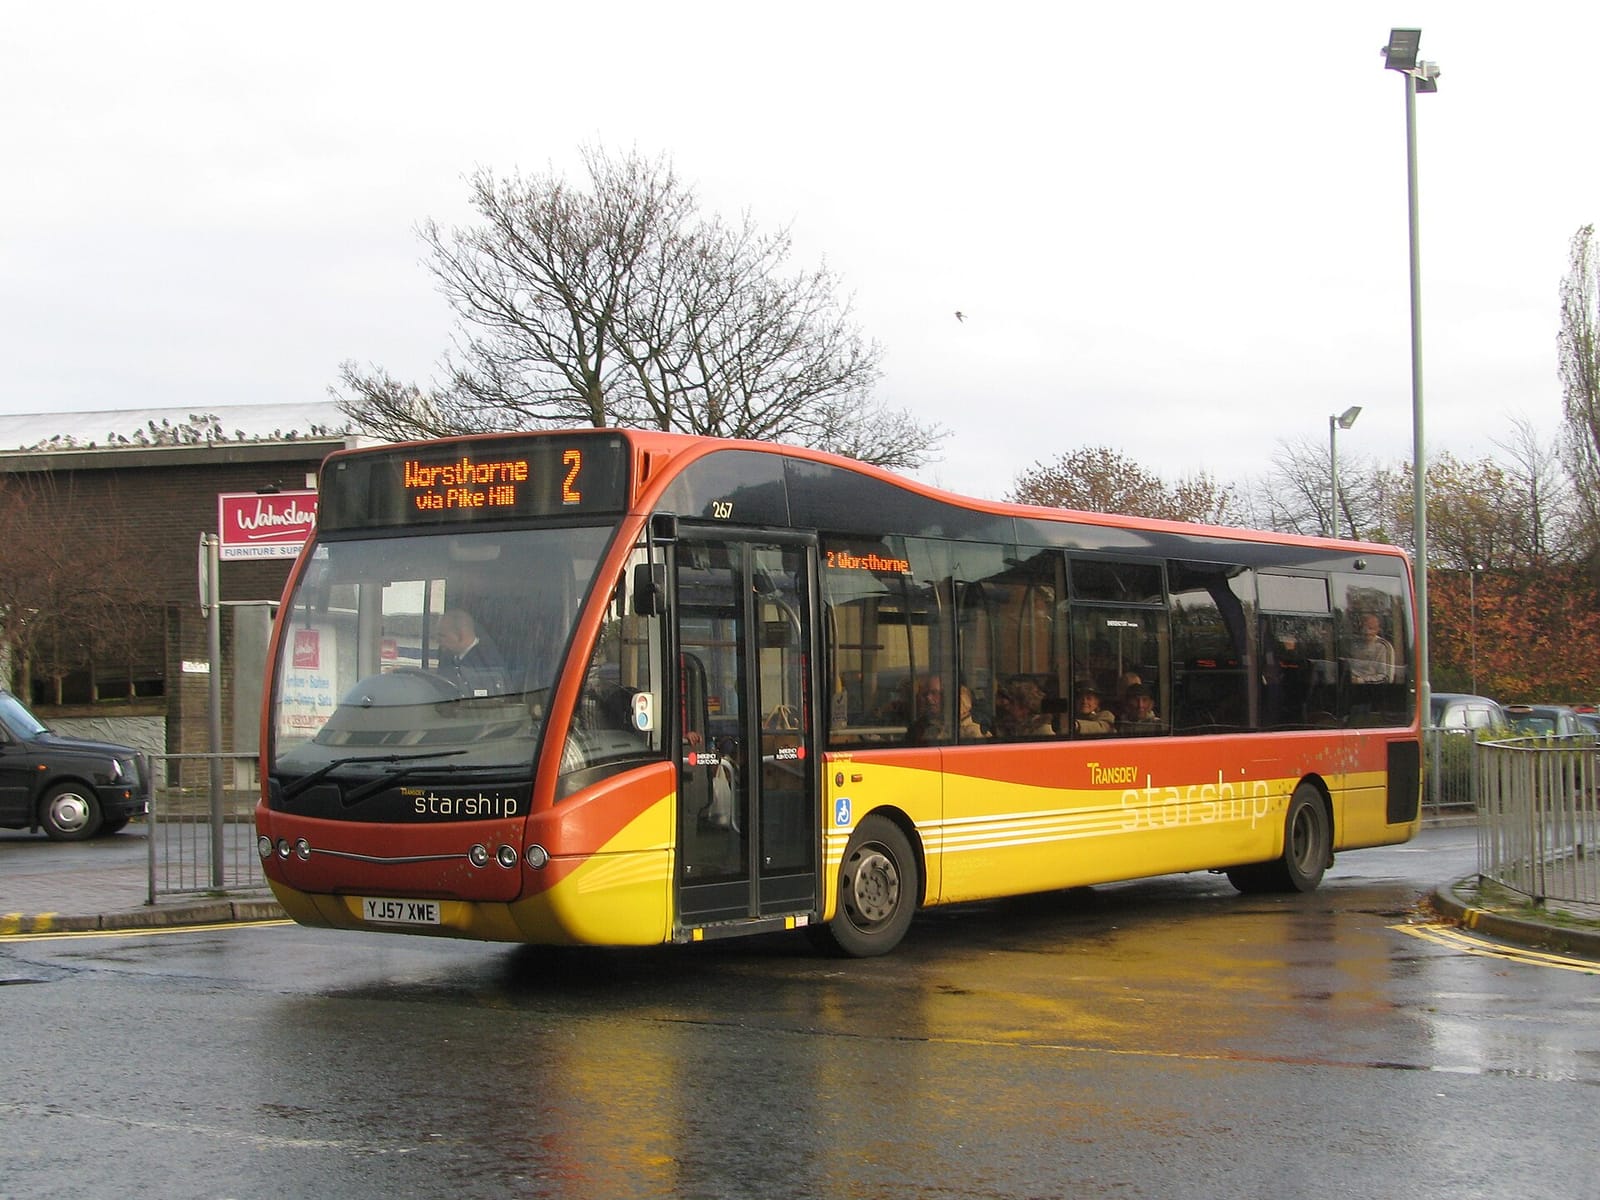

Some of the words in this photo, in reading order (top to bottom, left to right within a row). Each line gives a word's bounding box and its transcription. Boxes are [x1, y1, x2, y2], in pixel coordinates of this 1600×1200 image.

[405, 457, 528, 487] Worsthorne
[562, 449, 581, 502] 2
[416, 490, 443, 509] via
[447, 488, 485, 508] Pike
[488, 485, 515, 505] Hill
[712, 501, 734, 519] 267
[224, 547, 276, 557] FURNITURE
[827, 551, 835, 568] 2
[838, 551, 909, 572] Worsthorne
[1087, 762, 1138, 785] TRANSDEV
[415, 792, 518, 818] starship
[1121, 768, 1270, 830] starship
[368, 901, 403, 919] YJ57
[408, 903, 435, 921] XWE
